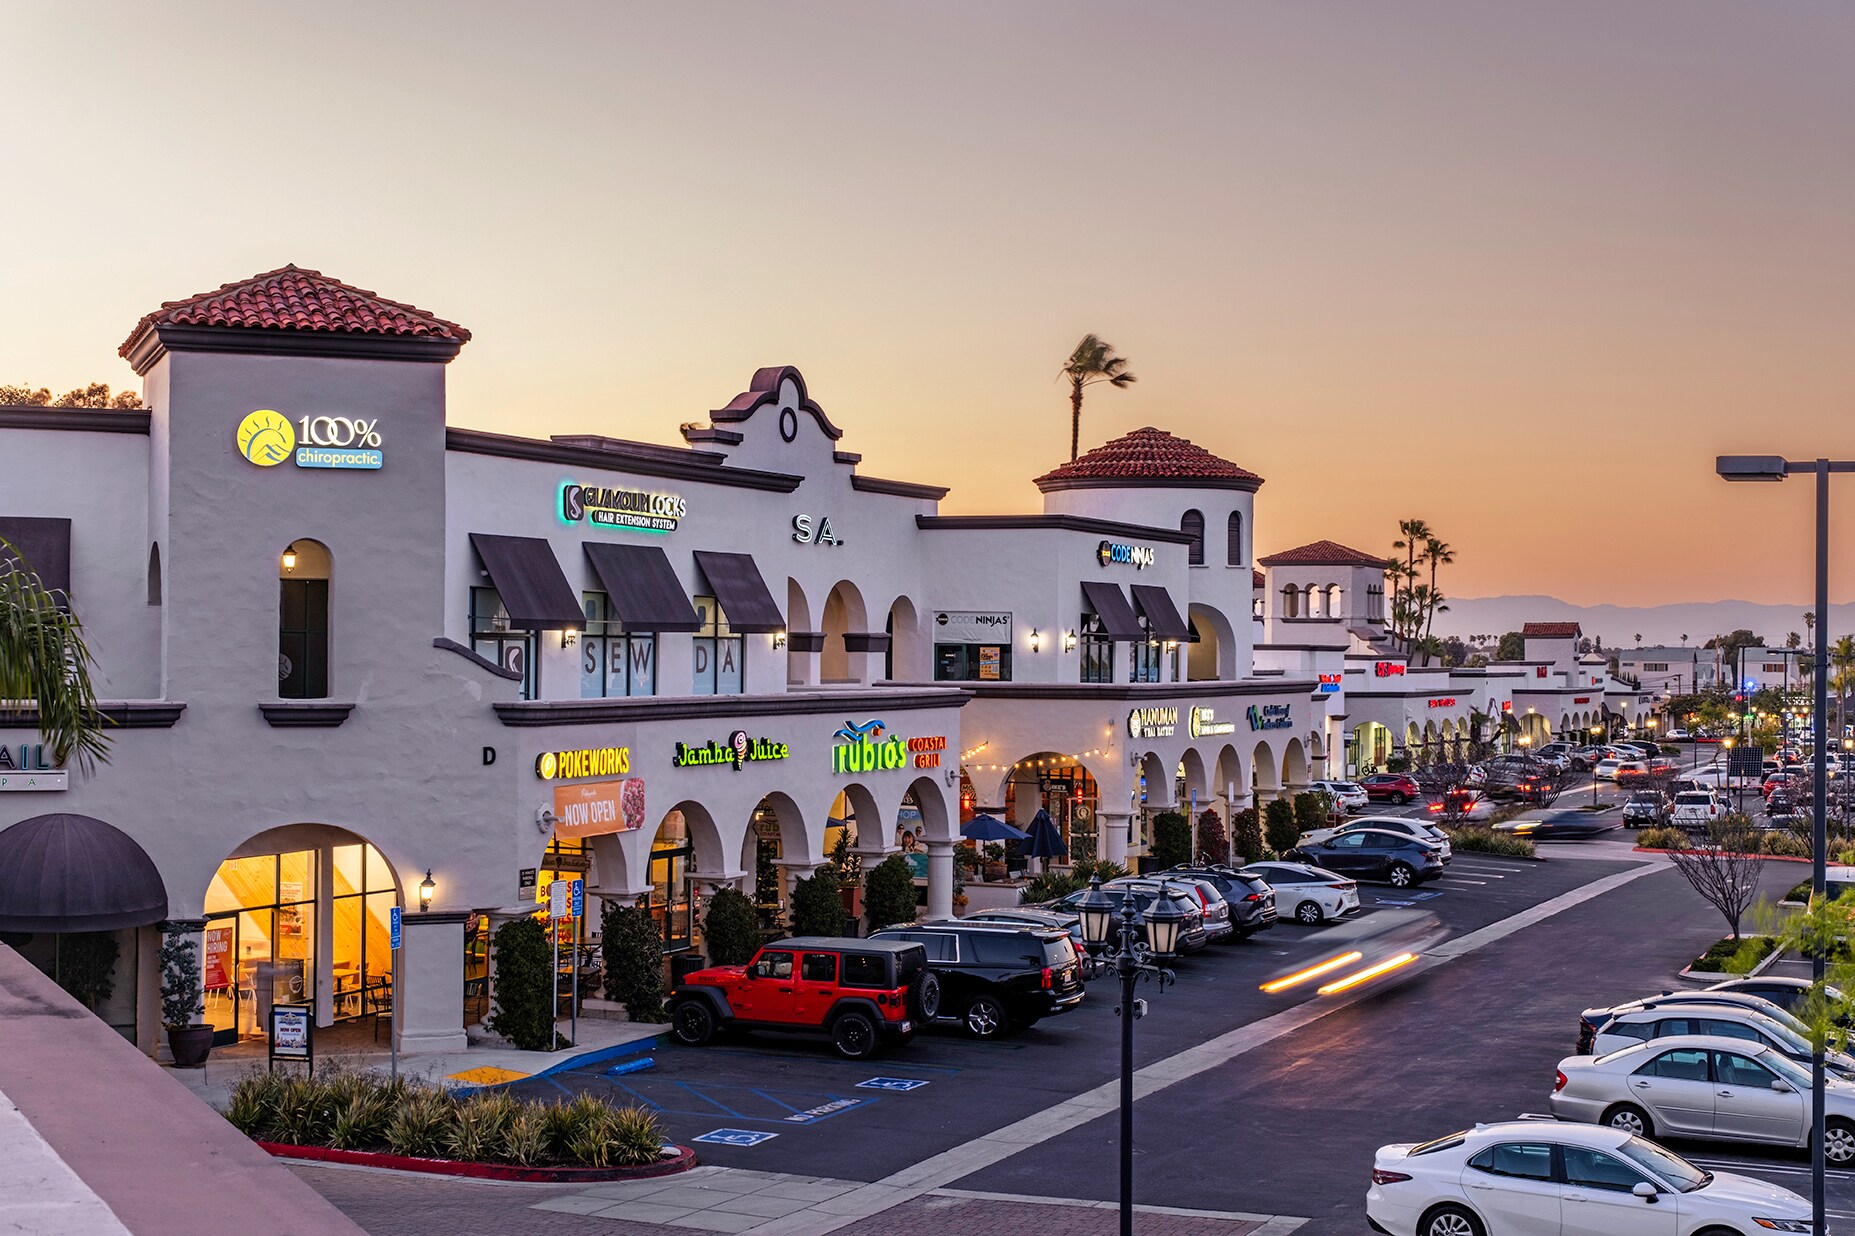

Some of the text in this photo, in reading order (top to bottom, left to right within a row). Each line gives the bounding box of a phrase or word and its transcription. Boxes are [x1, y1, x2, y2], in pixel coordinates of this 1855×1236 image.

[299, 415, 381, 447] 100%
[649, 495, 686, 517] LOCKS
[598, 511, 676, 530] HAIR EXTENSION SYSTEM
[1110, 543, 1131, 563] CODE
[950, 615, 975, 625] CODE
[1140, 706, 1178, 726] HANUMAN
[483, 746, 496, 766] D
[677, 738, 790, 767] Jamba Juice
[558, 747, 630, 779] POKEWORKS
[564, 799, 616, 827] NOW OPEN
[898, 810, 917, 819] HOP
[207, 928, 221, 942] NOW
[206, 941, 228, 955] HIRING
